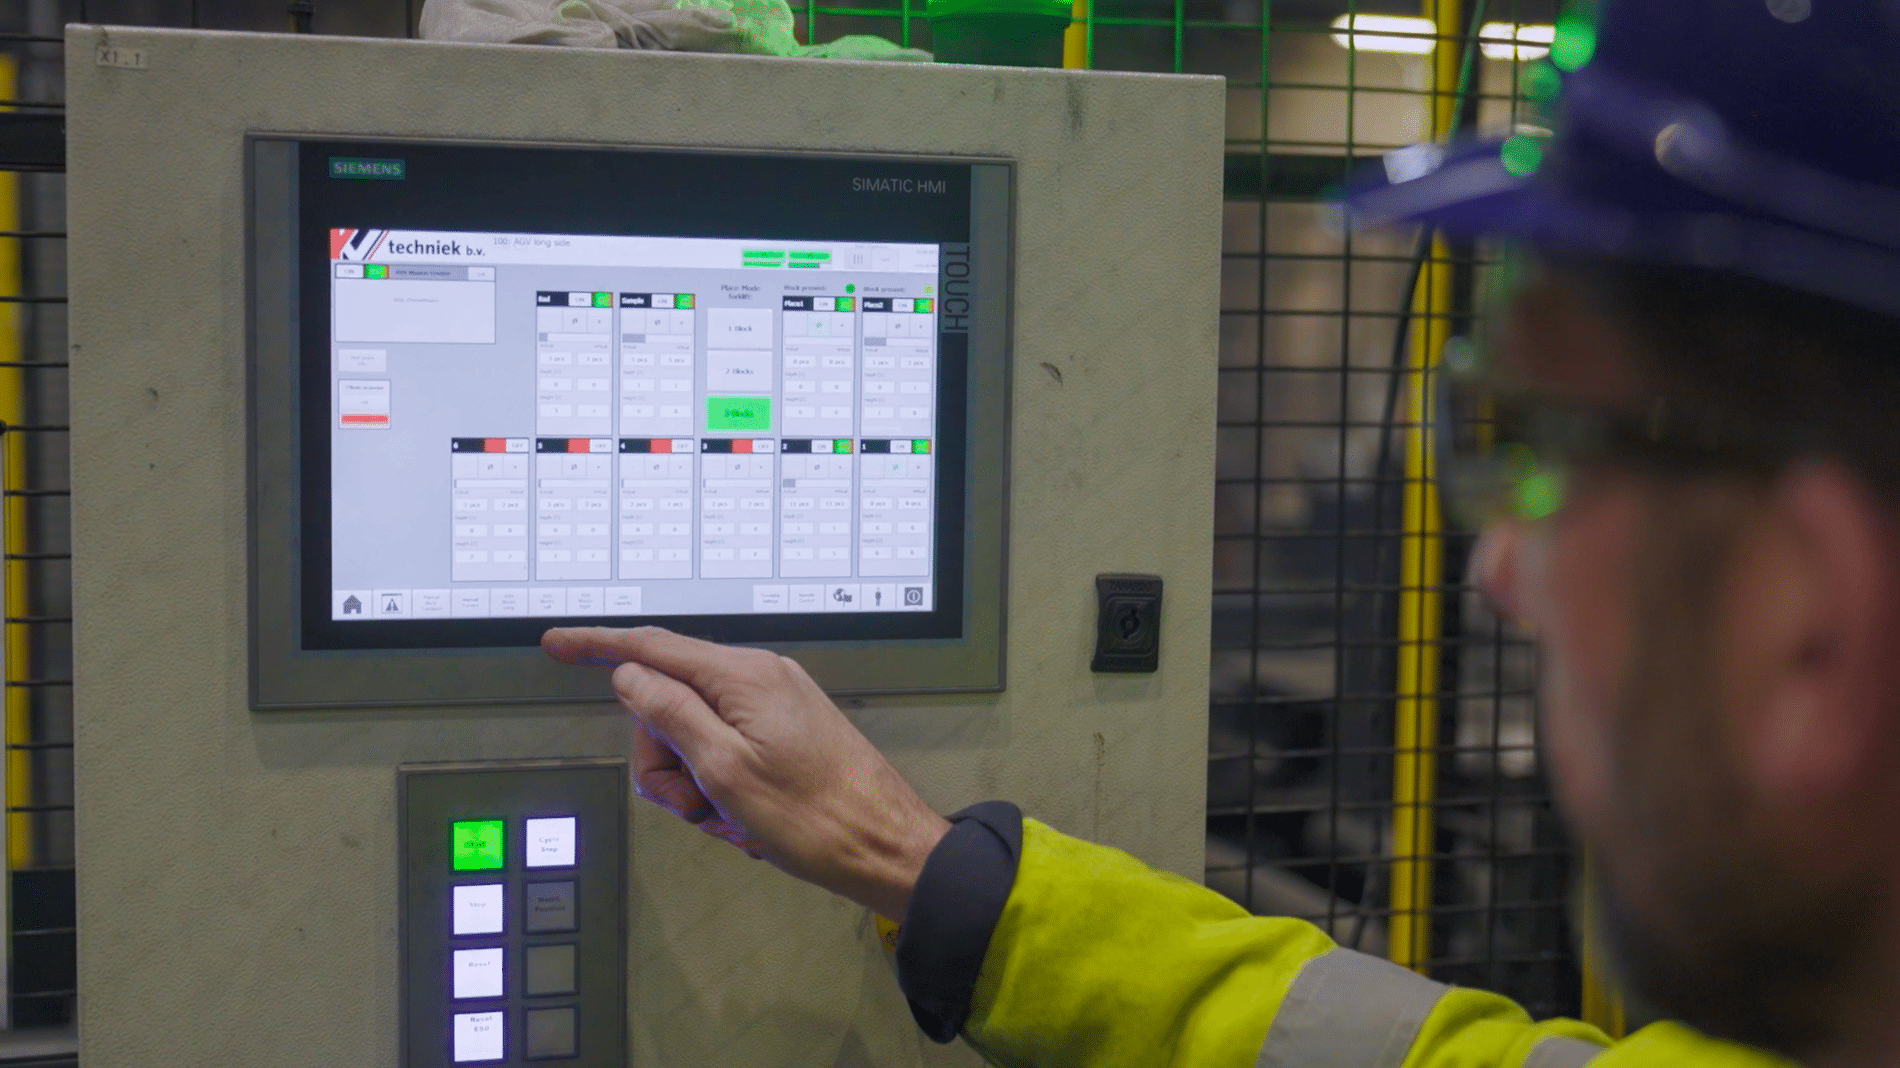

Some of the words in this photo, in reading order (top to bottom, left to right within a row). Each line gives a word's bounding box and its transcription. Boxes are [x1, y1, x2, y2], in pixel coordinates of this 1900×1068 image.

[333, 161, 402, 176] SIEMENS
[852, 177, 913, 193] SIMATIC
[917, 180, 946, 194] HMI
[388, 239, 461, 256] techniek
[465, 245, 486, 256] b.v.
[493, 238, 510, 246] 100:
[513, 238, 531, 246] AGV
[533, 238, 551, 248] long
[554, 239, 570, 247] side
[945, 246, 970, 330] TOUCH
